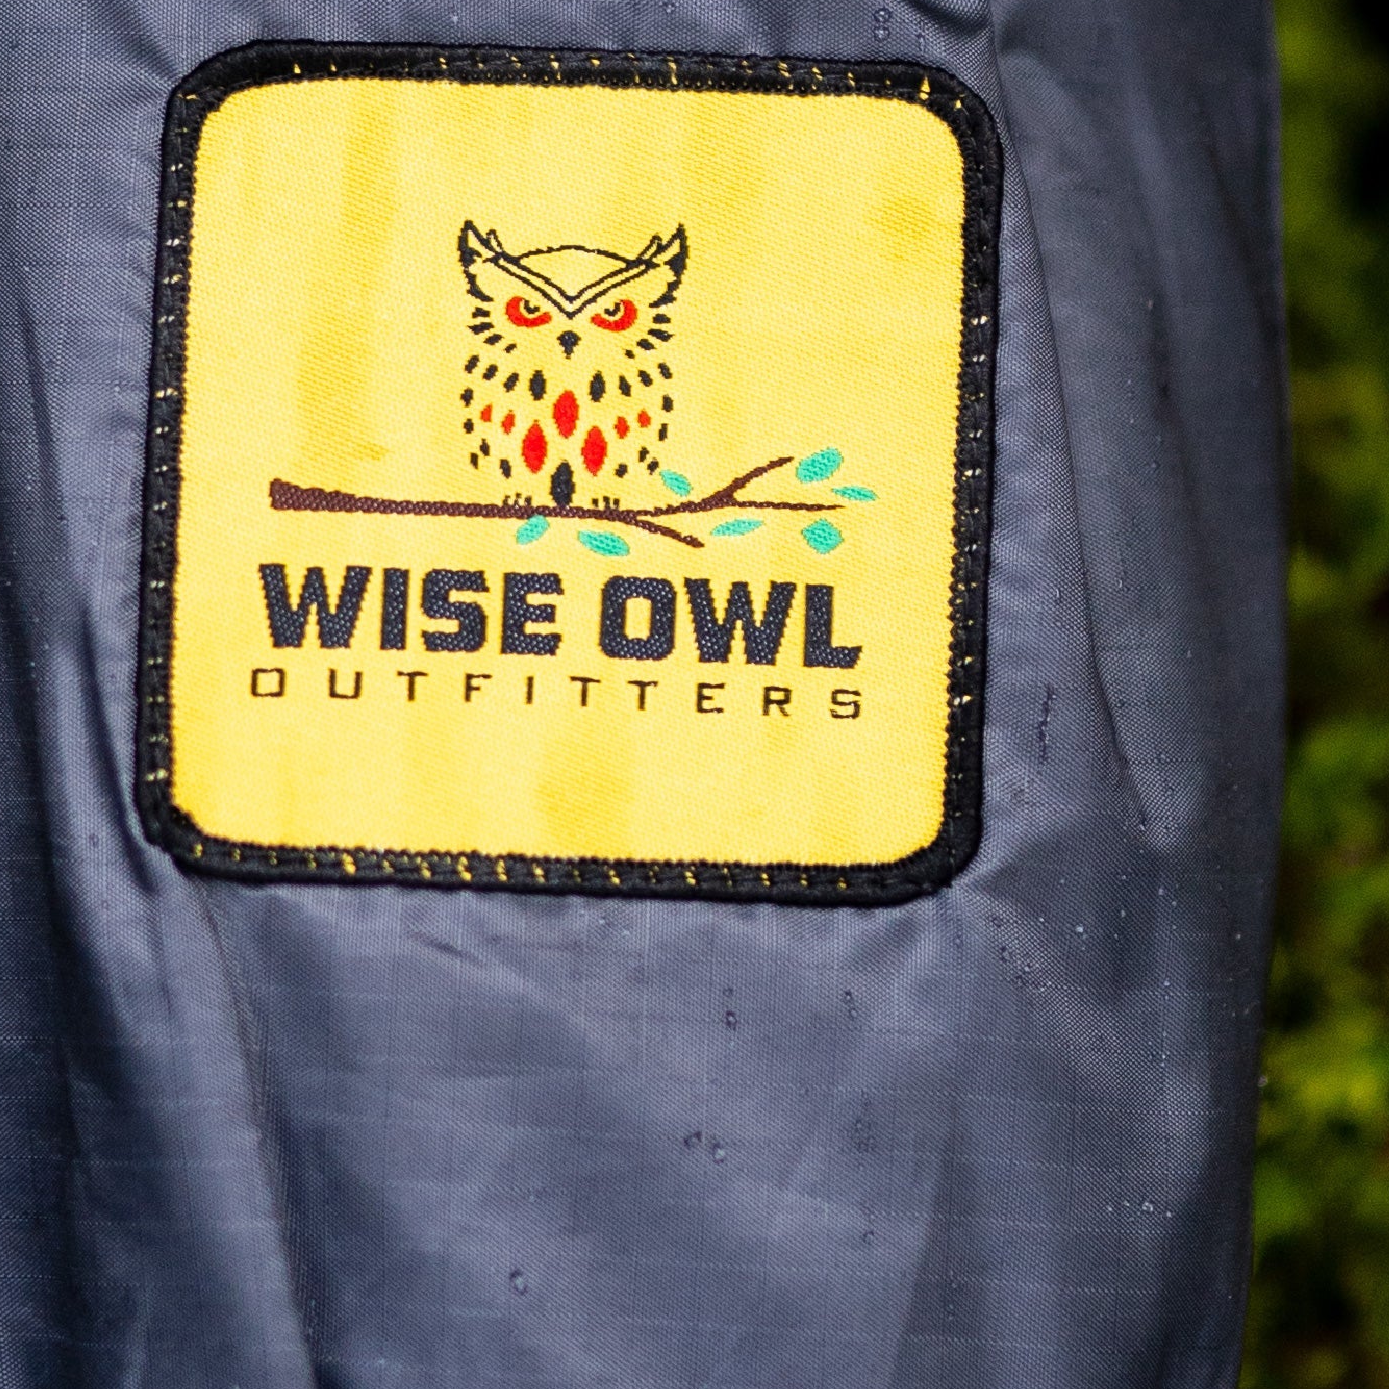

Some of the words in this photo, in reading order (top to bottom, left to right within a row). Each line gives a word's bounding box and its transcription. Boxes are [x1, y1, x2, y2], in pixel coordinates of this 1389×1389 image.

[258, 563, 564, 656] WISE
[599, 574, 863, 669] OWL
[250, 667, 862, 720] OUTFITTERS
